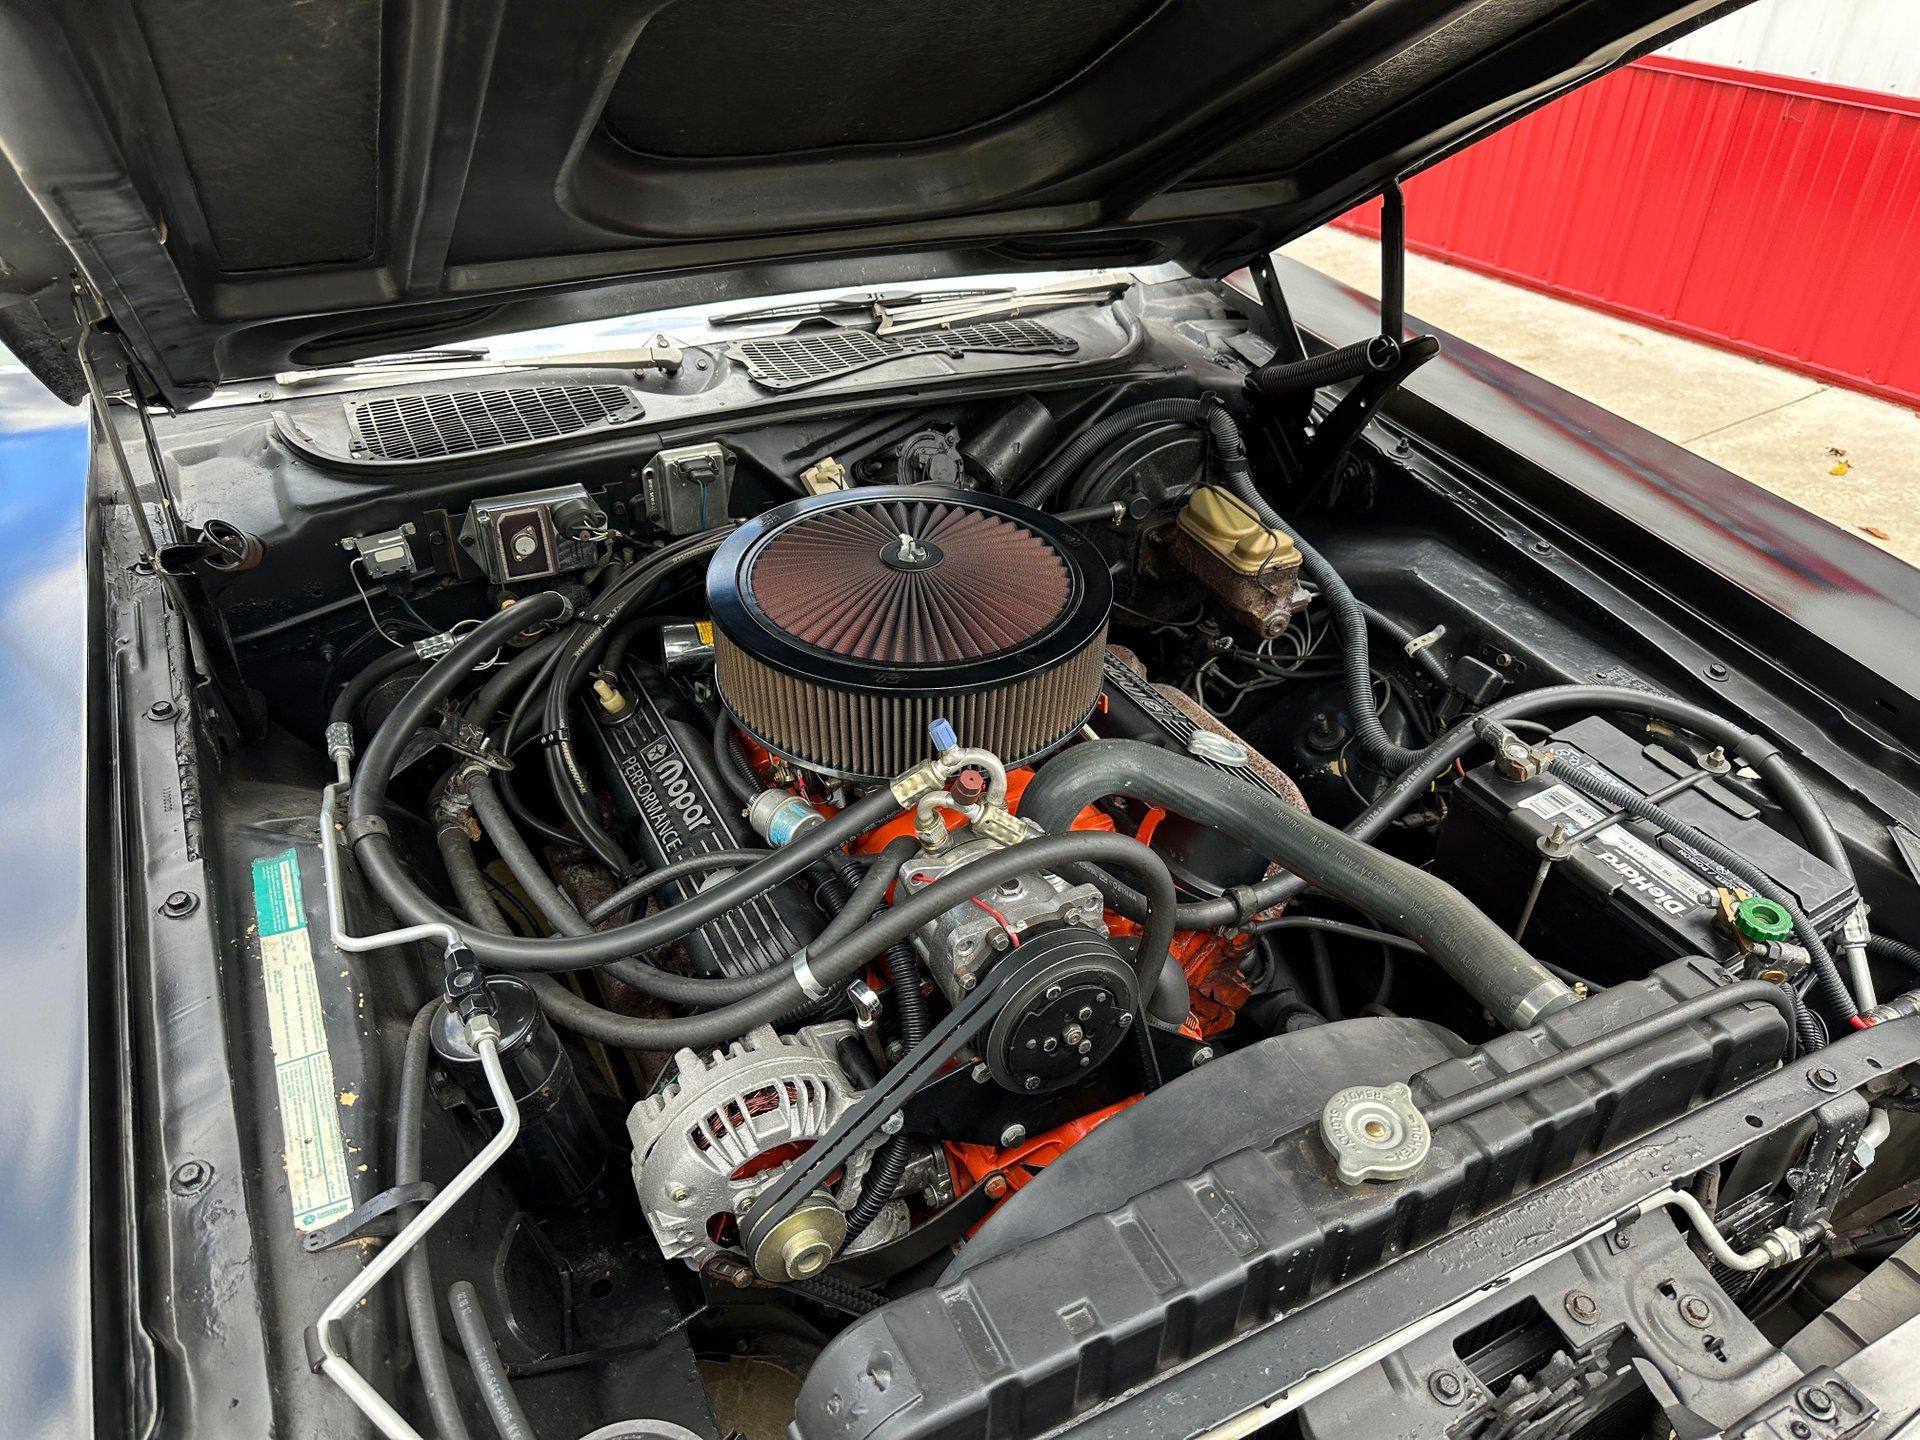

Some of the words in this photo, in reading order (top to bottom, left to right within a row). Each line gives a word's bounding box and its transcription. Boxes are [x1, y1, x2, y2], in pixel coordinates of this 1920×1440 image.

[656, 759, 712, 832] Mopar
[1394, 765, 1426, 793] Parker
[622, 756, 684, 853] PERFORMANCE
[1678, 849, 1710, 871] POISON
[1594, 850, 1687, 915] DieHard
[1338, 1090, 1382, 1107] REMOVE
[1399, 1122, 1423, 1162] TIGHTEN
